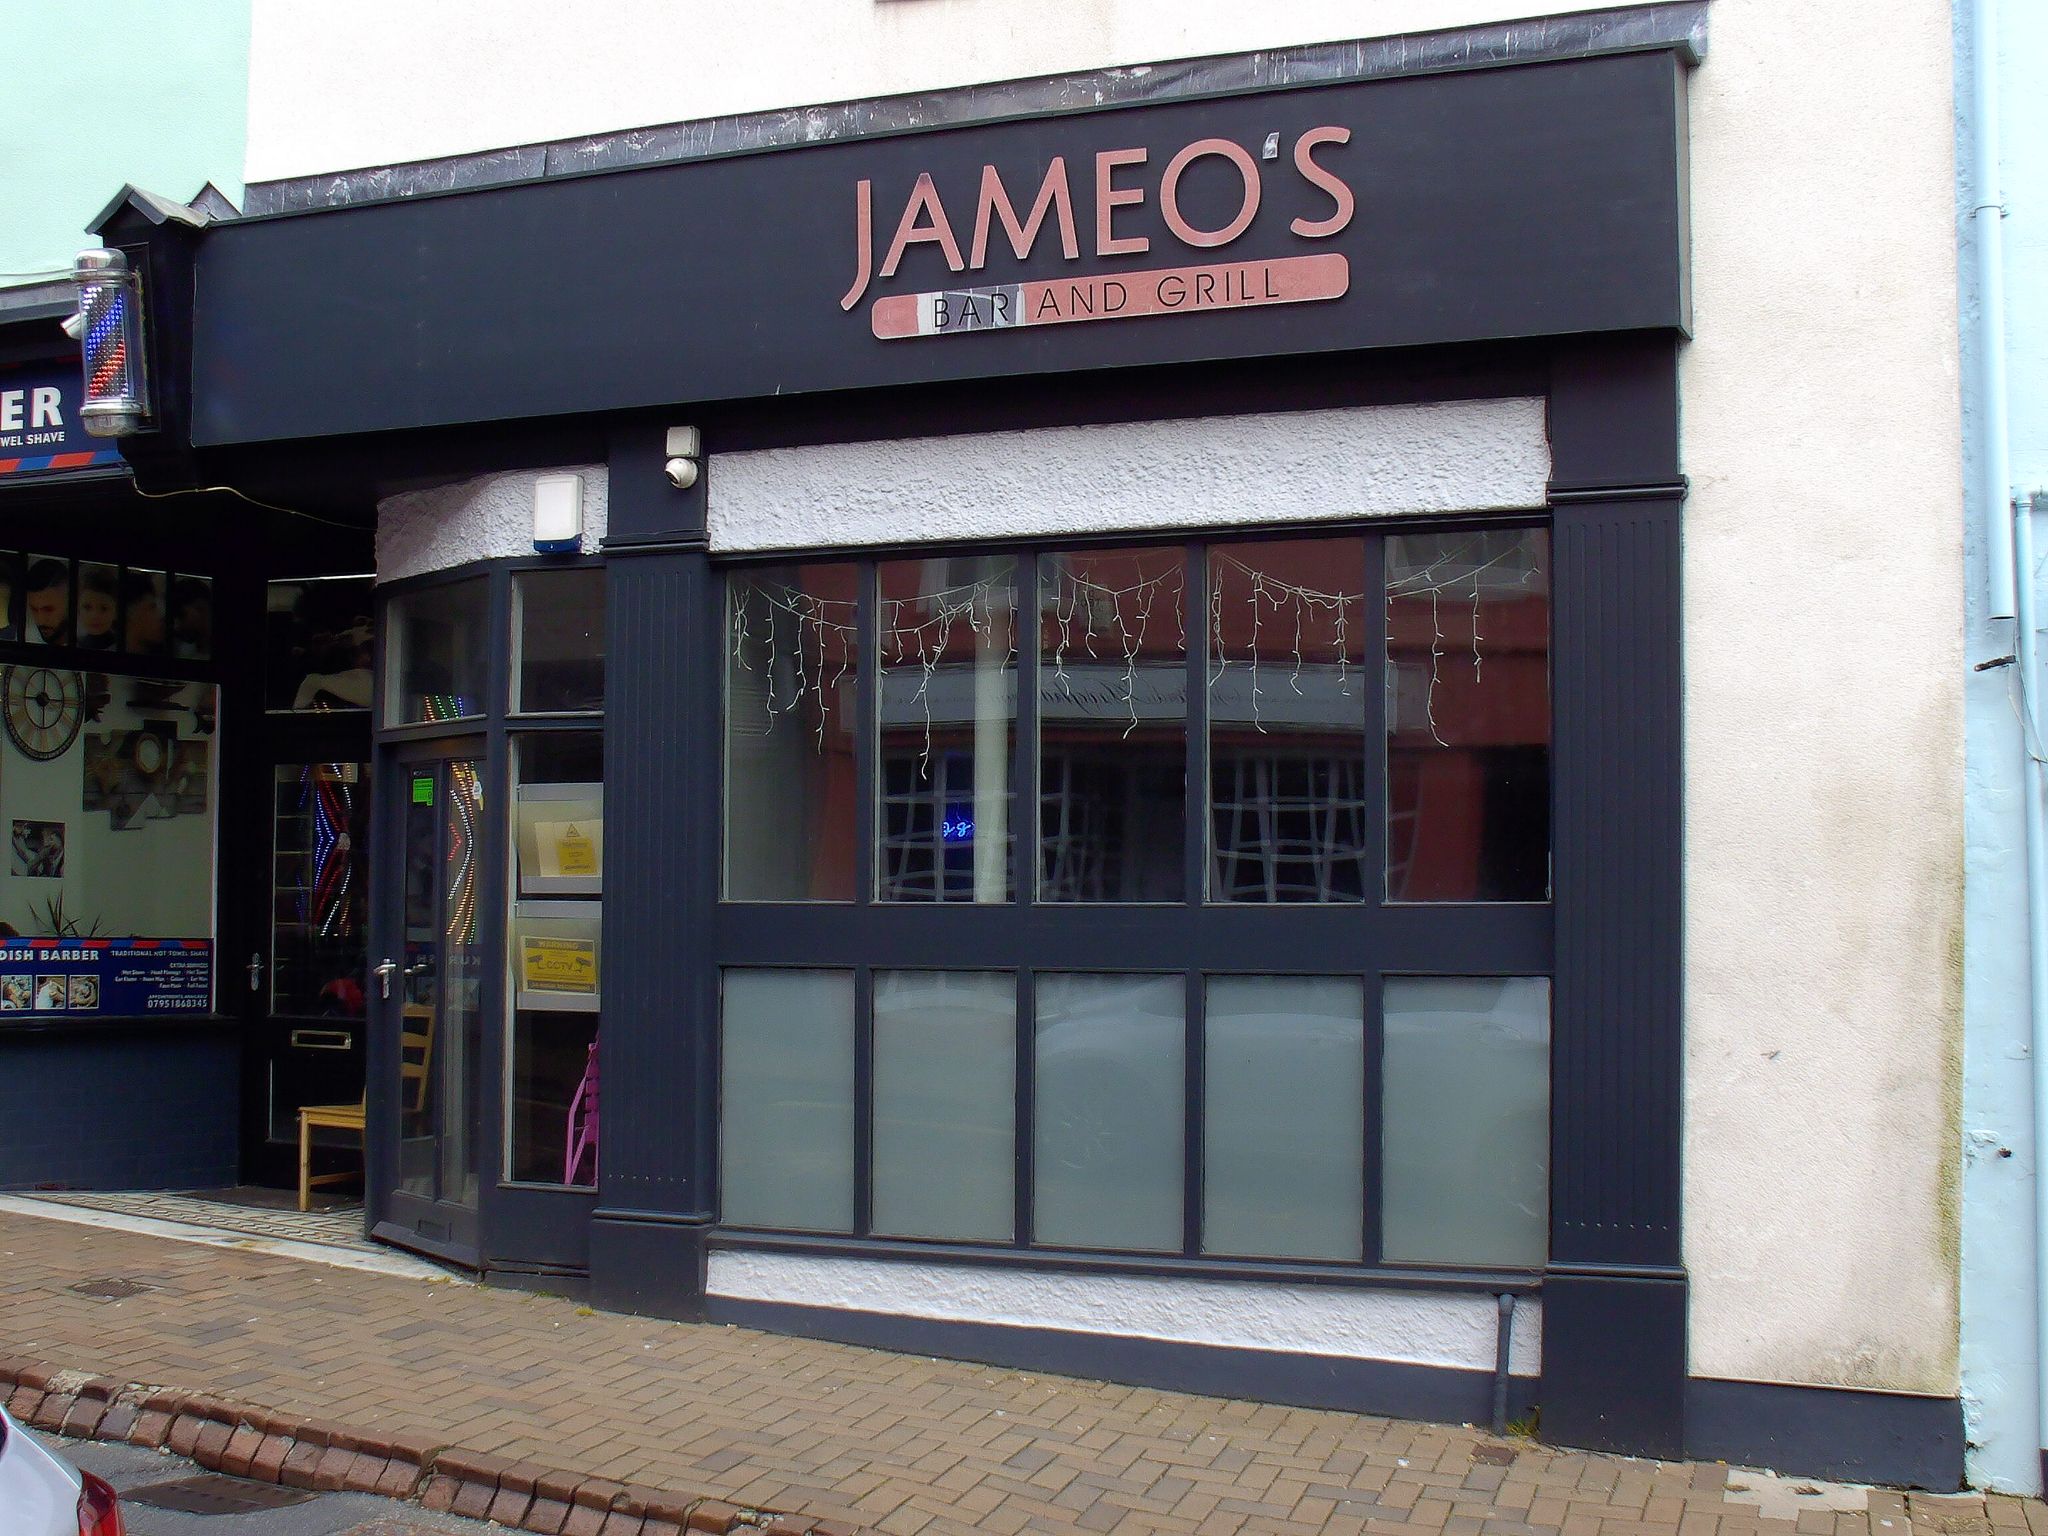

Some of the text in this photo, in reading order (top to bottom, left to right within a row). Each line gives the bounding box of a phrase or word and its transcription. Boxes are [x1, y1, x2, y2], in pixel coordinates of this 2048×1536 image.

[840, 126, 1354, 311] JAMEO'S
[933, 267, 1280, 328] BAR AND GRILL
[0, 386, 64, 432] ER
[26, 431, 65, 445] SHAVE
[0, 949, 100, 961] DISH BARBER
